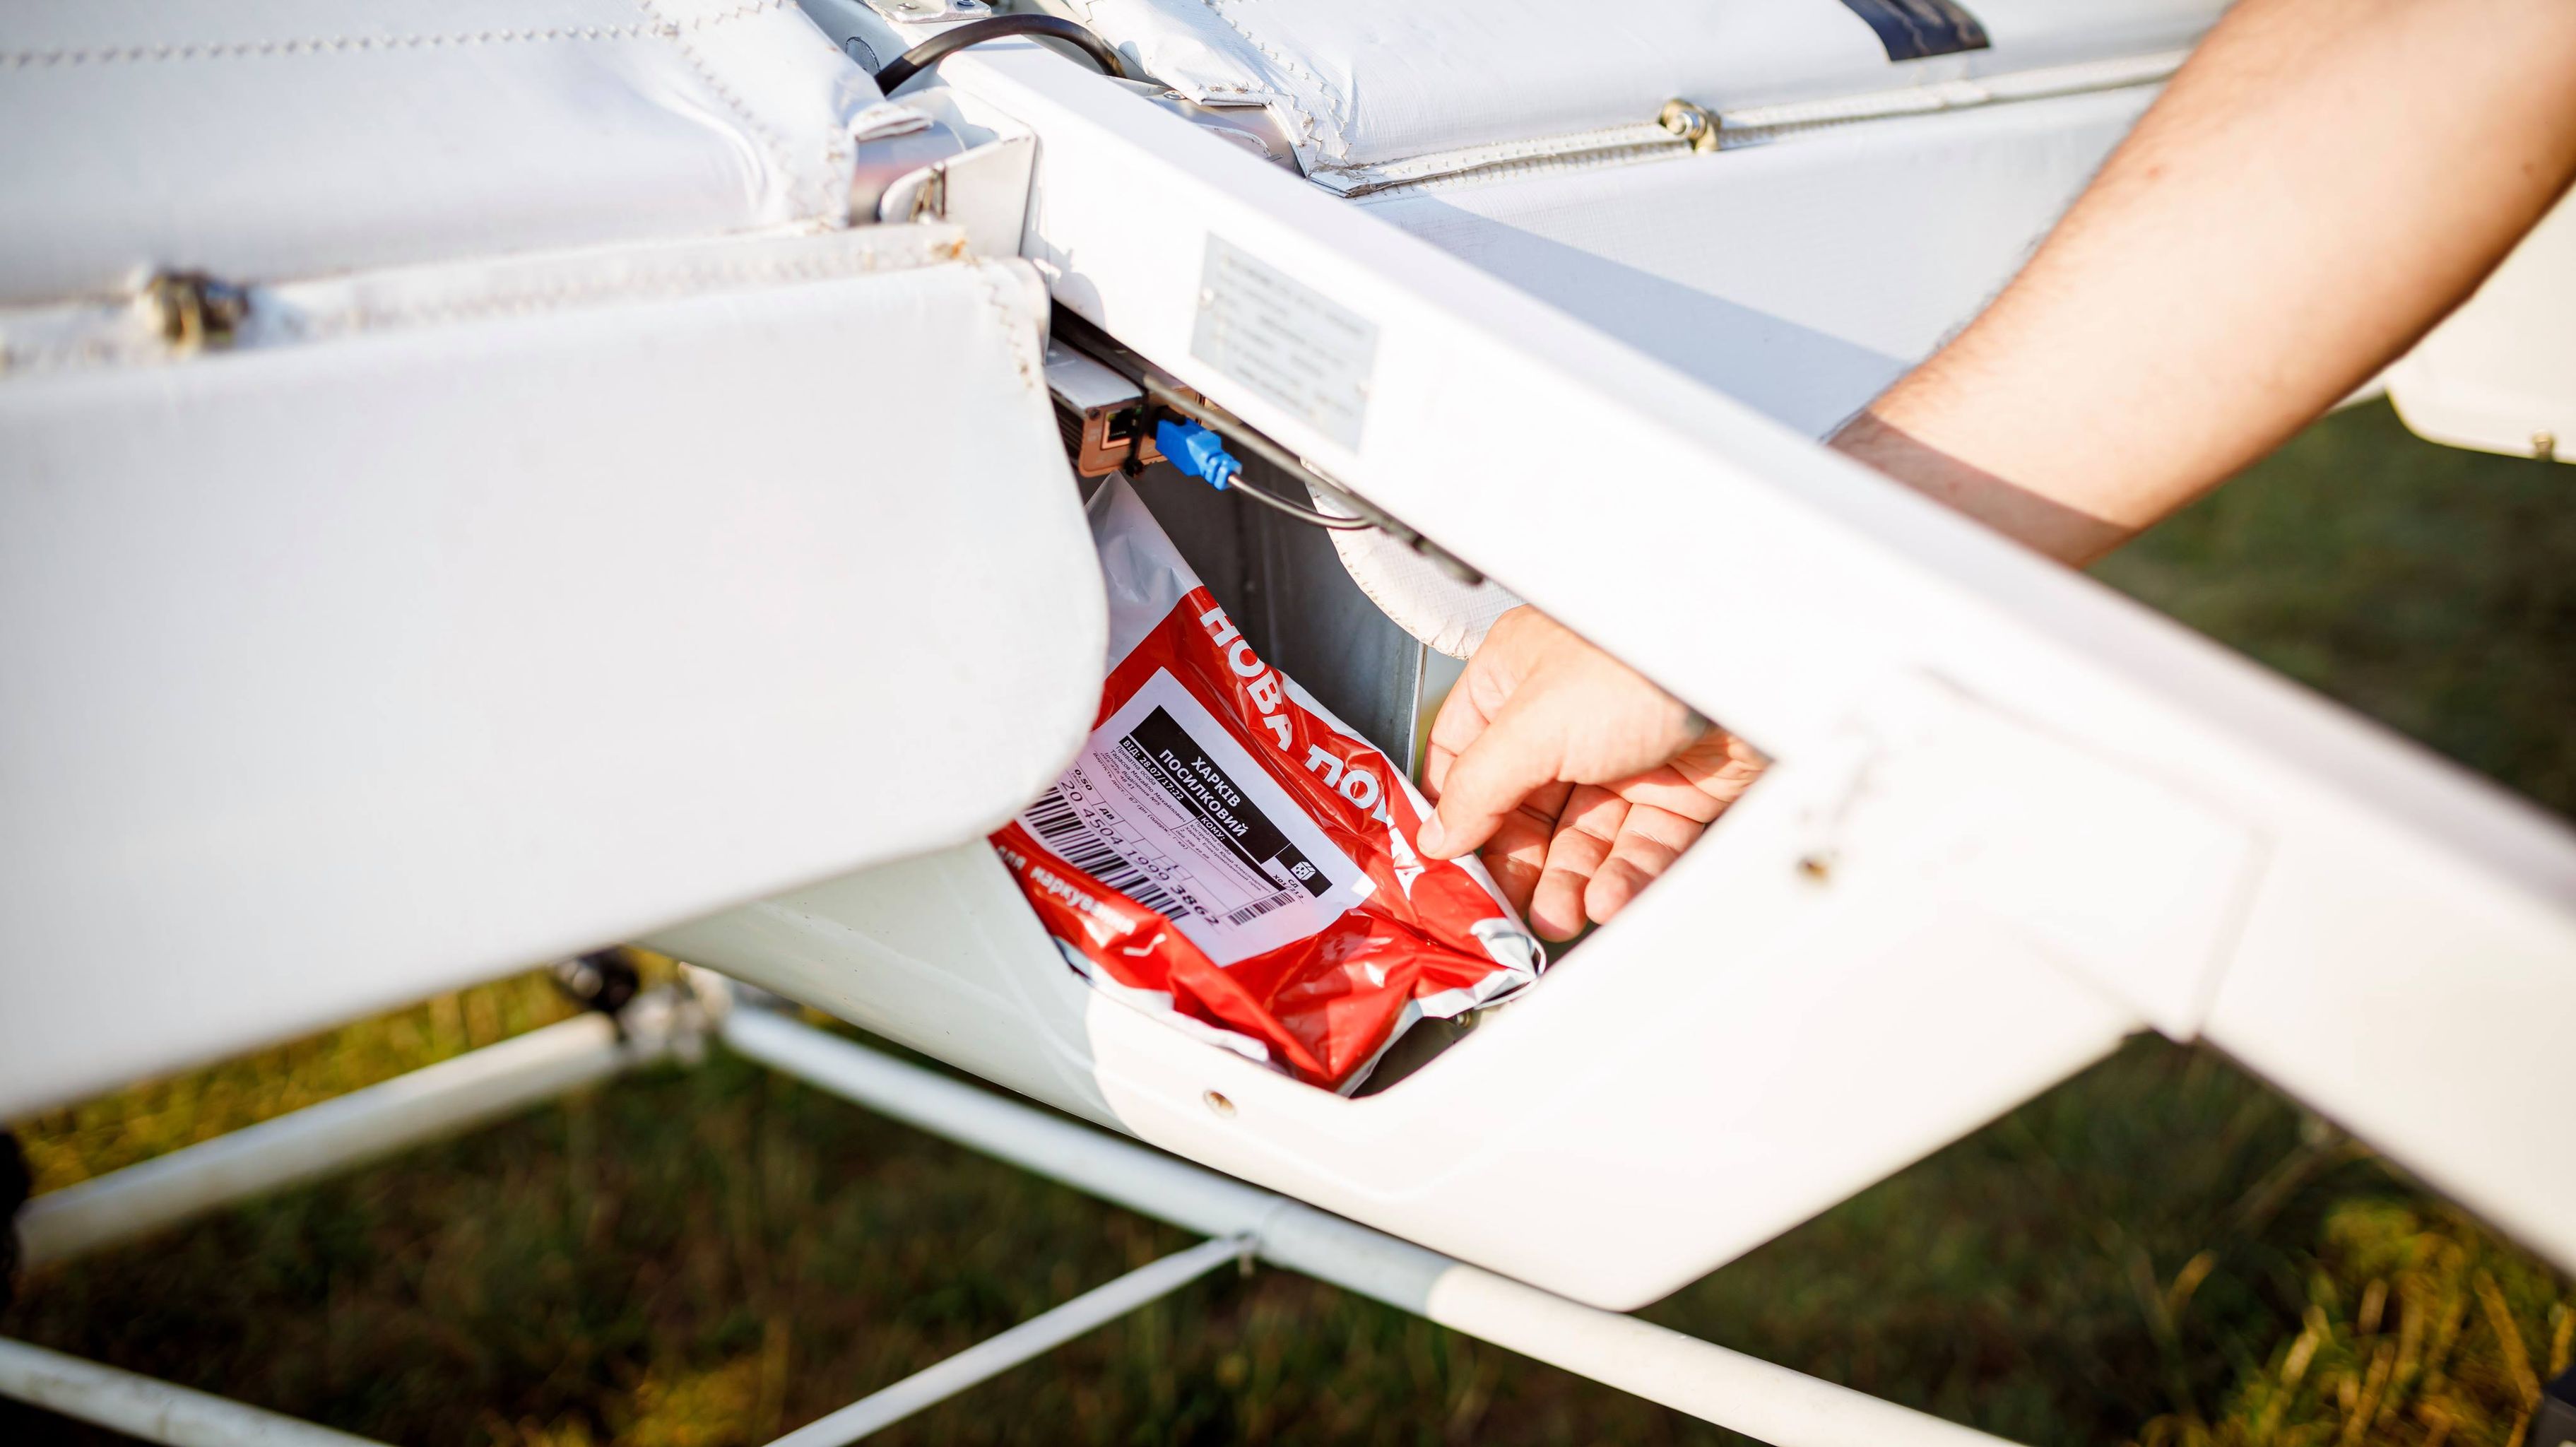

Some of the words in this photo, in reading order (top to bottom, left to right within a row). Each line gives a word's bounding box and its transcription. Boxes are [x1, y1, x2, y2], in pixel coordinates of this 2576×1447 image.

[1199, 606, 1292, 752] НОВА
[1074, 769, 1092, 791] 0.50
[1110, 750, 1131, 770] Тарасов
[1131, 770, 1154, 793] Михайло
[1154, 792, 1186, 822] Михайлович
[1116, 745, 1141, 771] Приватна
[1140, 770, 1157, 786] особа
[1122, 740, 1140, 757] ВІД:
[1140, 757, 1184, 801] 28.07/17:22
[1191, 756, 1241, 807] ХАРКІВ
[1099, 808, 1115, 820] ДВ
[1136, 805, 1147, 814] грн
[1159, 749, 1248, 837] ПОСИЛКОВИЙ
[1195, 821, 1217, 842] Приватна
[1217, 842, 1231, 855] особа
[1200, 817, 1225, 840] КОМУ:
[1060, 780, 1082, 802] 20
[1083, 808, 1123, 845] 4504
[1125, 850, 1169, 880] 1999
[1169, 884, 1219, 926] 3862
